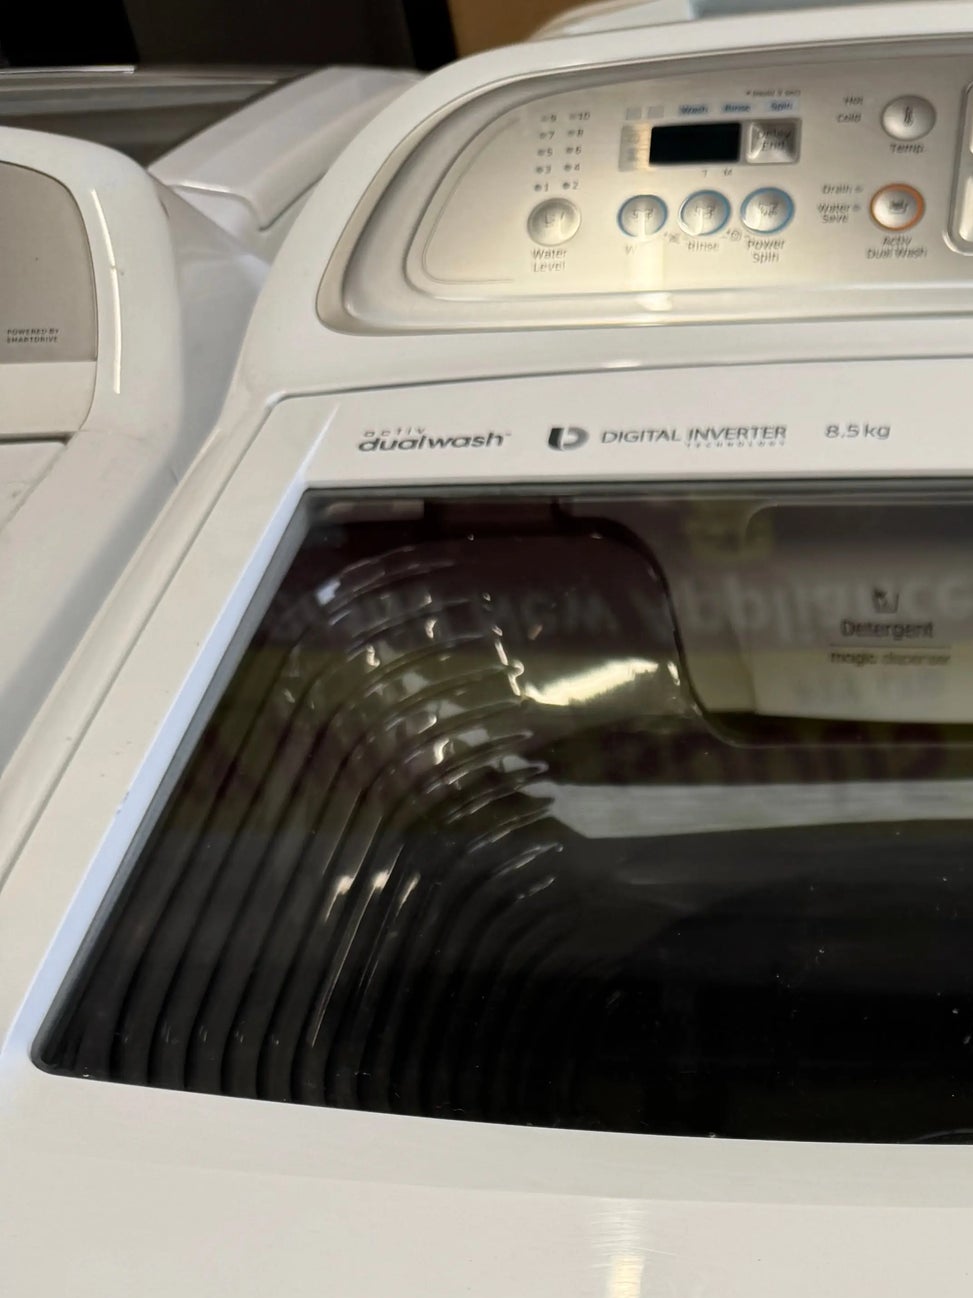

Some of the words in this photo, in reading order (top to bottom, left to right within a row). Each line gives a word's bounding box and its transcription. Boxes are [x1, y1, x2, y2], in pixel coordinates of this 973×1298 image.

[532, 249, 568, 260] Water
[533, 262, 566, 273] Level
[600, 429, 680, 444] DIGITAL
[687, 424, 787, 441] INVERTER
[840, 620, 934, 640] Detergent
